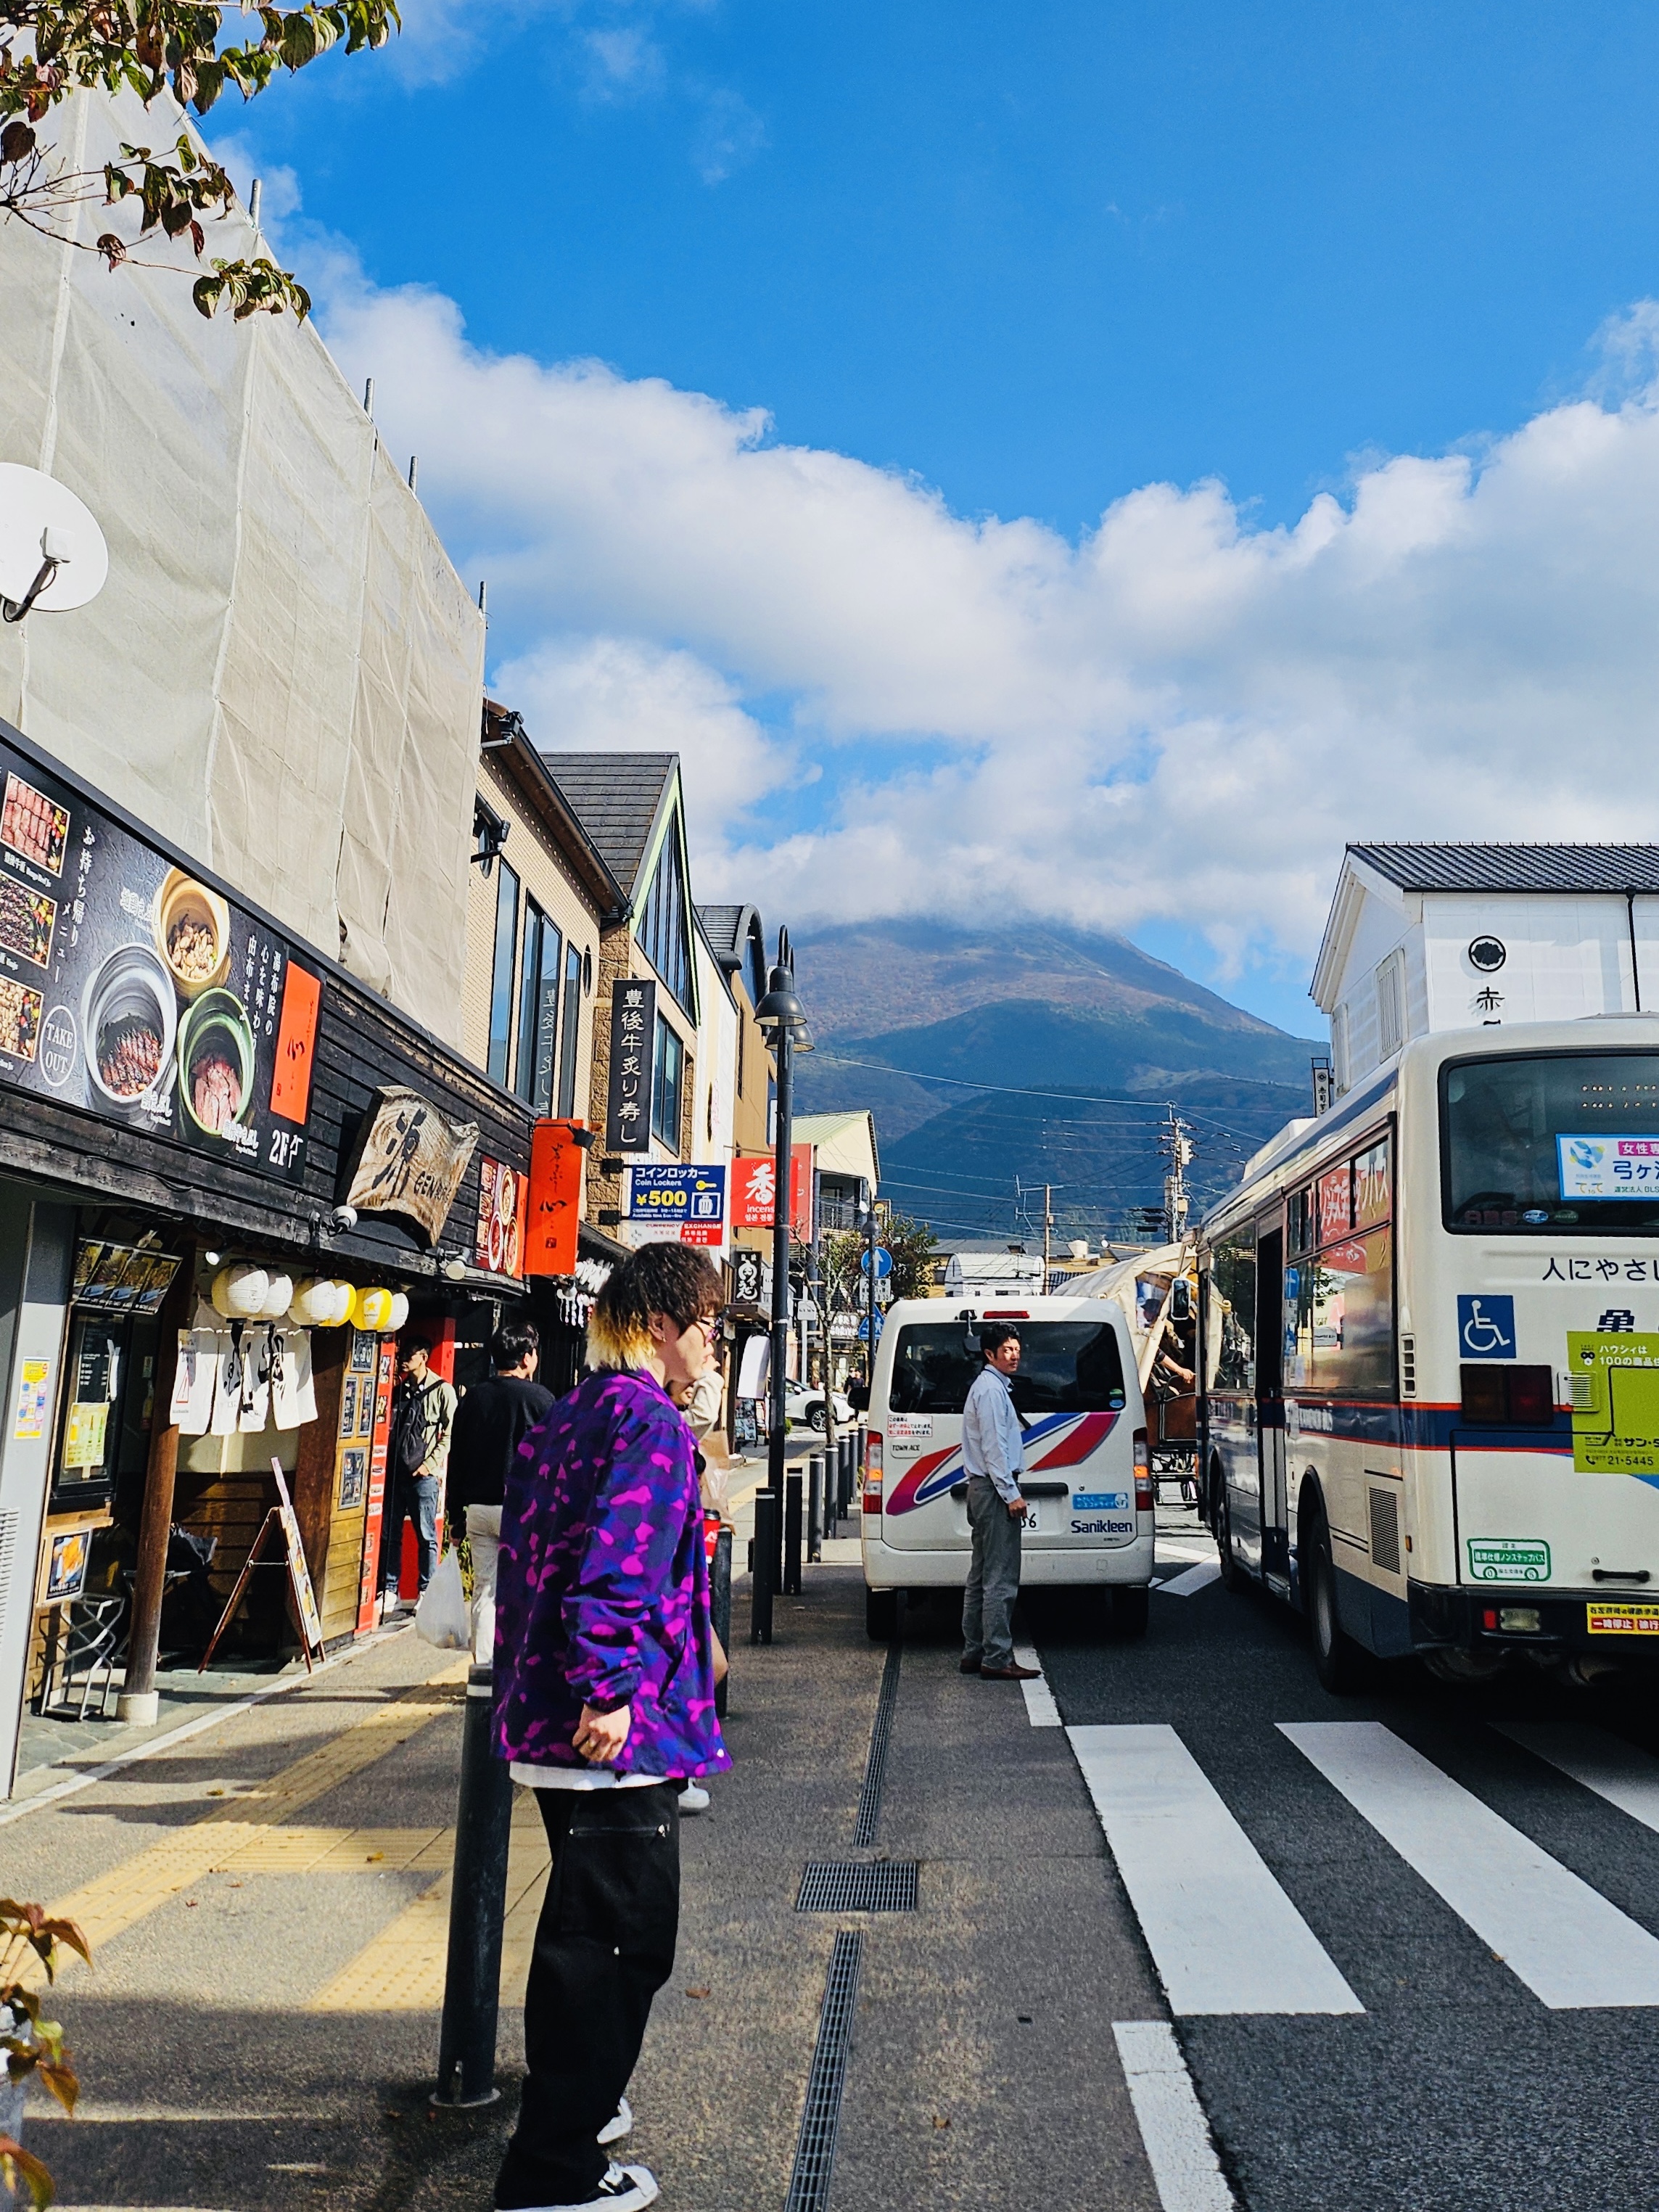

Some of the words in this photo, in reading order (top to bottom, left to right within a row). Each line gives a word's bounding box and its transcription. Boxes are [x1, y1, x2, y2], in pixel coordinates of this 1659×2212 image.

[70, 825, 96, 947] お持ち帰り
[54, 902, 71, 984] メニュー
[265, 950, 281, 1036] 湯布院の
[46, 1022, 73, 1050] TAKE
[45, 1051, 68, 1074] OUT
[617, 989, 645, 1143] 豊後牛炙り寿し
[268, 1130, 289, 1166] 2F
[635, 1167, 709, 1178] コインロッカー
[744, 1162, 775, 1204] 香
[636, 1191, 687, 1206] ¥500
[1600, 1345, 1647, 1354] ハウシィは
[1071, 1520, 1132, 1533] Sanikleen
